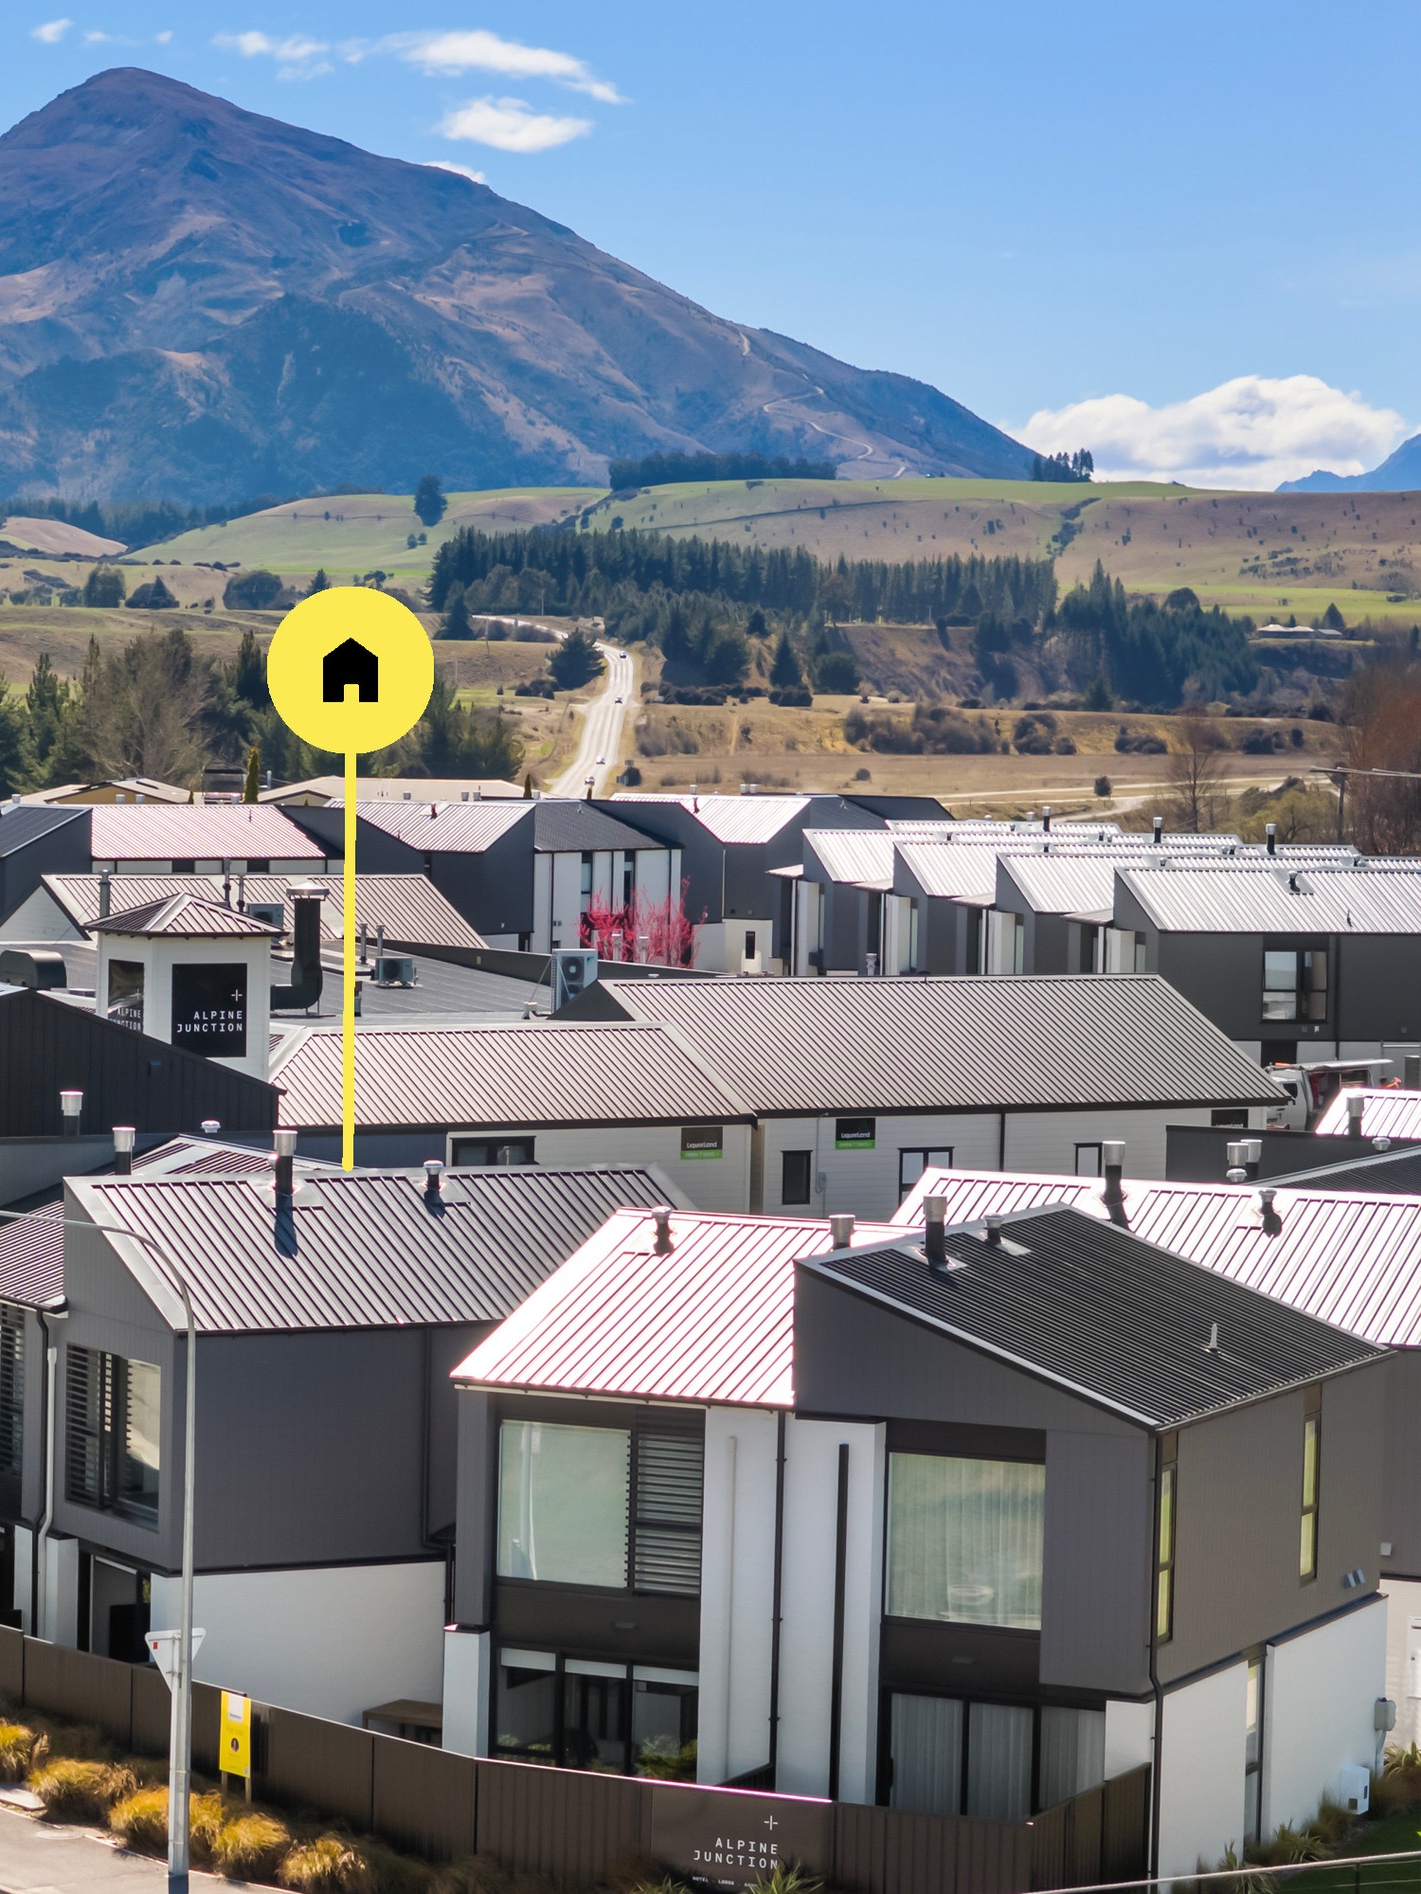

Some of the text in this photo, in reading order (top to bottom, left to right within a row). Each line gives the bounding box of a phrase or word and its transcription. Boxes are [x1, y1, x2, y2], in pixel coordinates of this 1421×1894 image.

[116, 1007, 141, 1019] ALPINE
[193, 1010, 243, 1020] ALPINE
[176, 1023, 243, 1033] JUNCTION
[715, 1837, 778, 1855] ALPINE
[693, 1850, 778, 1870] JUNCTION
